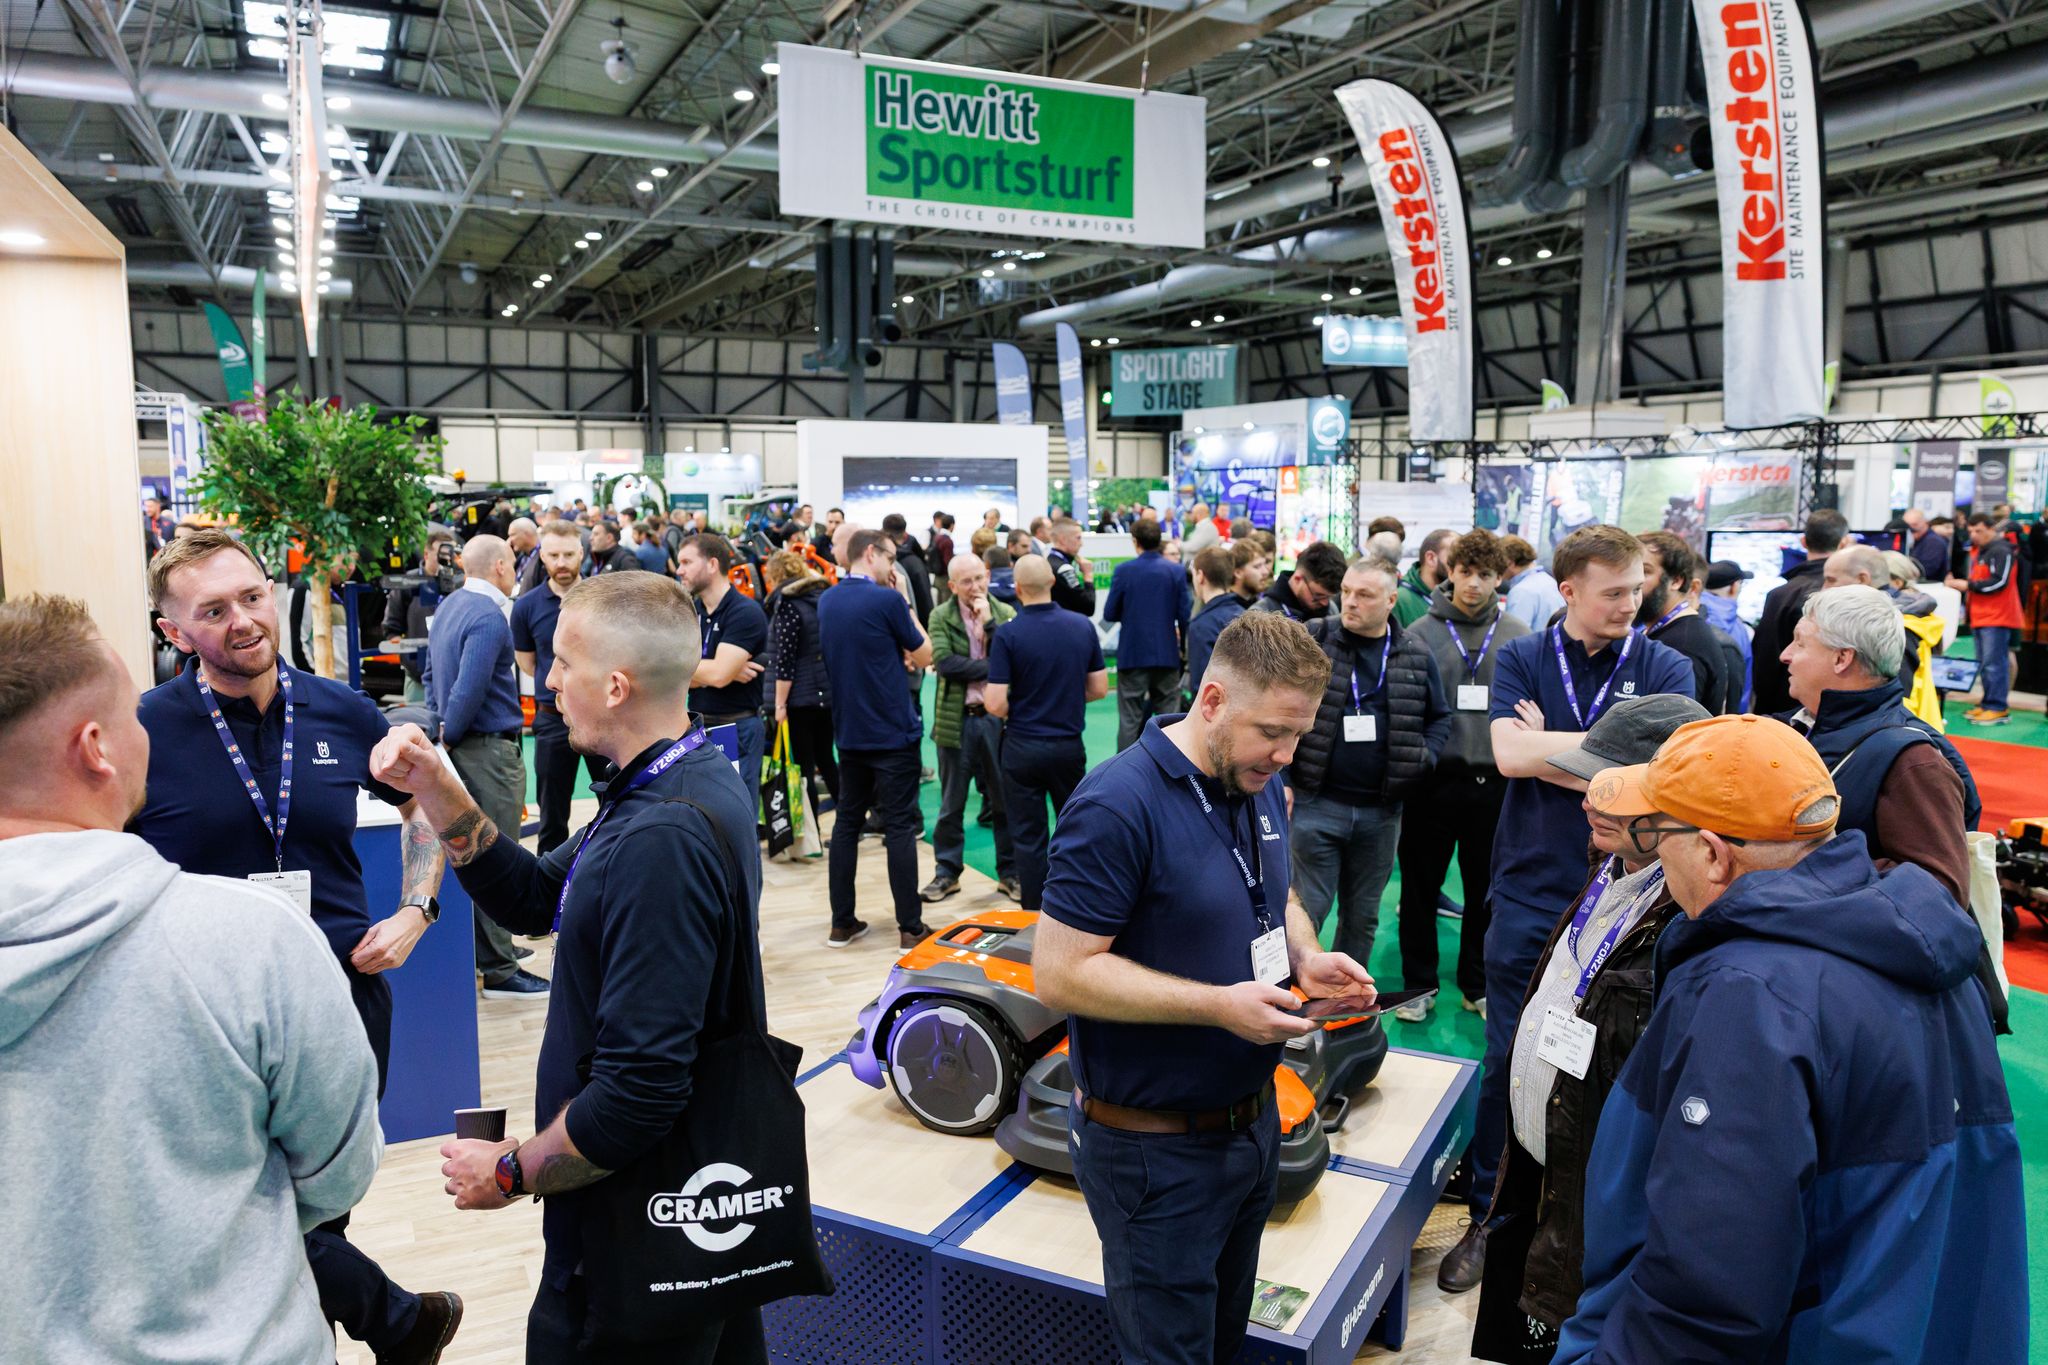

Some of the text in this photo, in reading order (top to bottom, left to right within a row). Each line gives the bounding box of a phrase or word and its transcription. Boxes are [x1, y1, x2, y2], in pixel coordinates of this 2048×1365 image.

[876, 72, 1039, 144] Hewitt
[1721, 2, 1786, 281] Kersten
[1769, 1, 1804, 279] SITE MAINTENANCE EQUIPMENT
[878, 133, 1121, 202] Sportsturf
[867, 201, 1136, 234] THE CHOICE OF CHAMPIONS
[1379, 128, 1446, 334] Kersten
[1438, 203, 1456, 299] MAINTENANCE
[1448, 307, 1459, 331] SITE
[1143, 382, 1203, 410] STAGE
[648, 744, 686, 775] FORZA
[1232, 848, 1254, 881] Husqvarna
[1586, 941, 1611, 978] FORZA
[649, 1260, 794, 1292] 100% Battery. Power. Productivity.
[1349, 1263, 1384, 1333] Husqvarna
